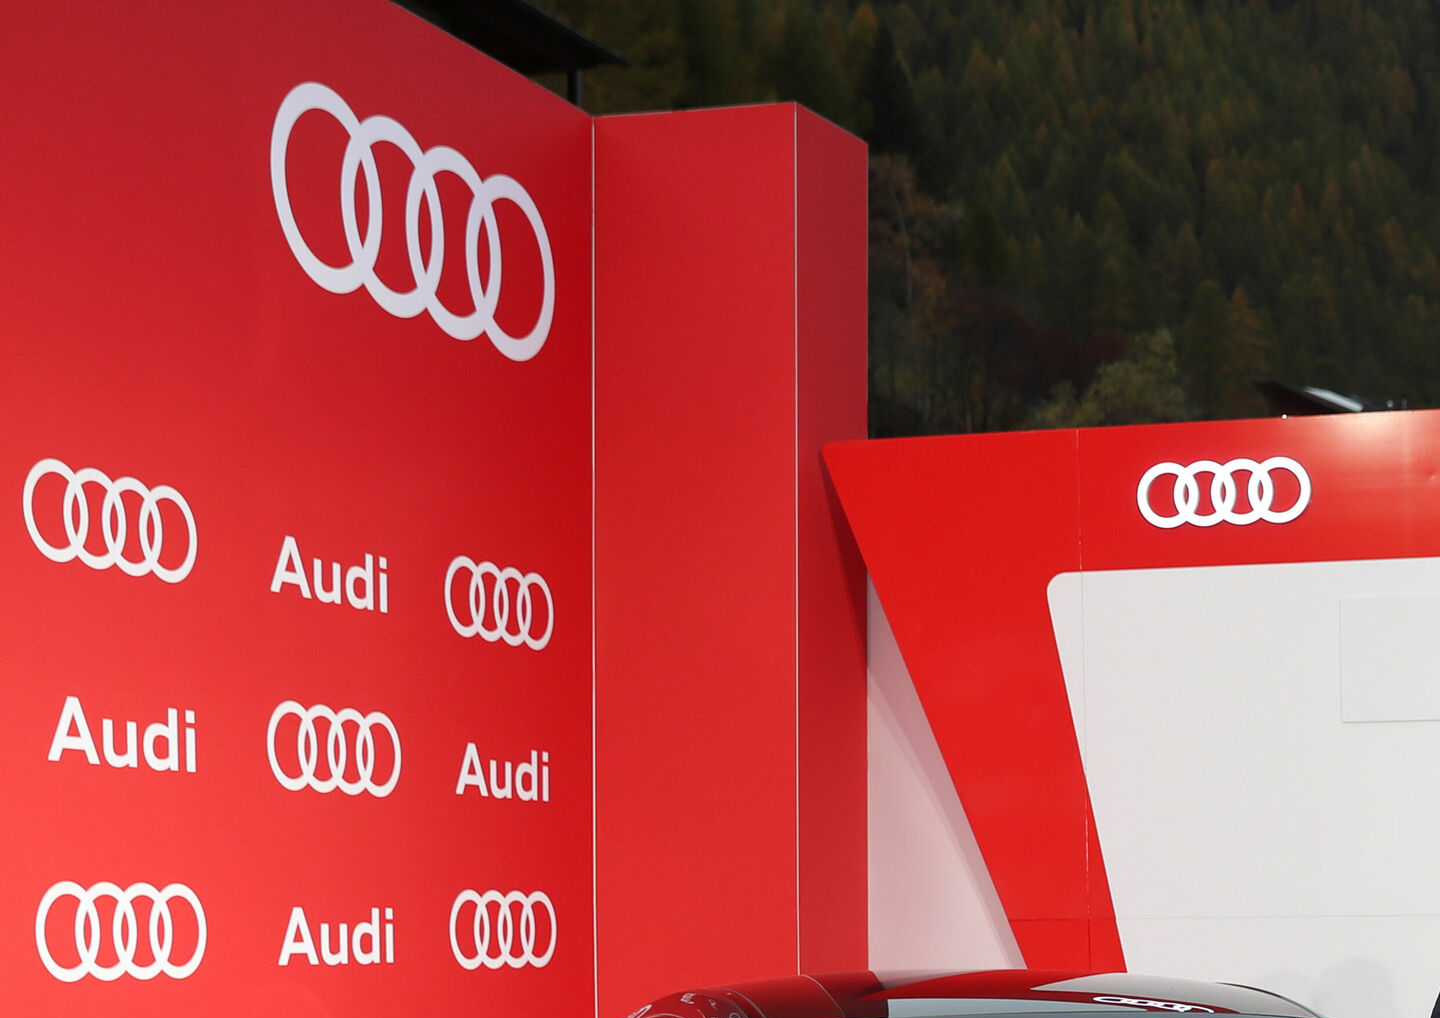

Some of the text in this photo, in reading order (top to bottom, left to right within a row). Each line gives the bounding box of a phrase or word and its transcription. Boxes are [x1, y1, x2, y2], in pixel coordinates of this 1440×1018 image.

[271, 536, 388, 613] Audi
[48, 696, 197, 773] Audi
[456, 743, 549, 802] Audi
[278, 907, 395, 967] Audi
